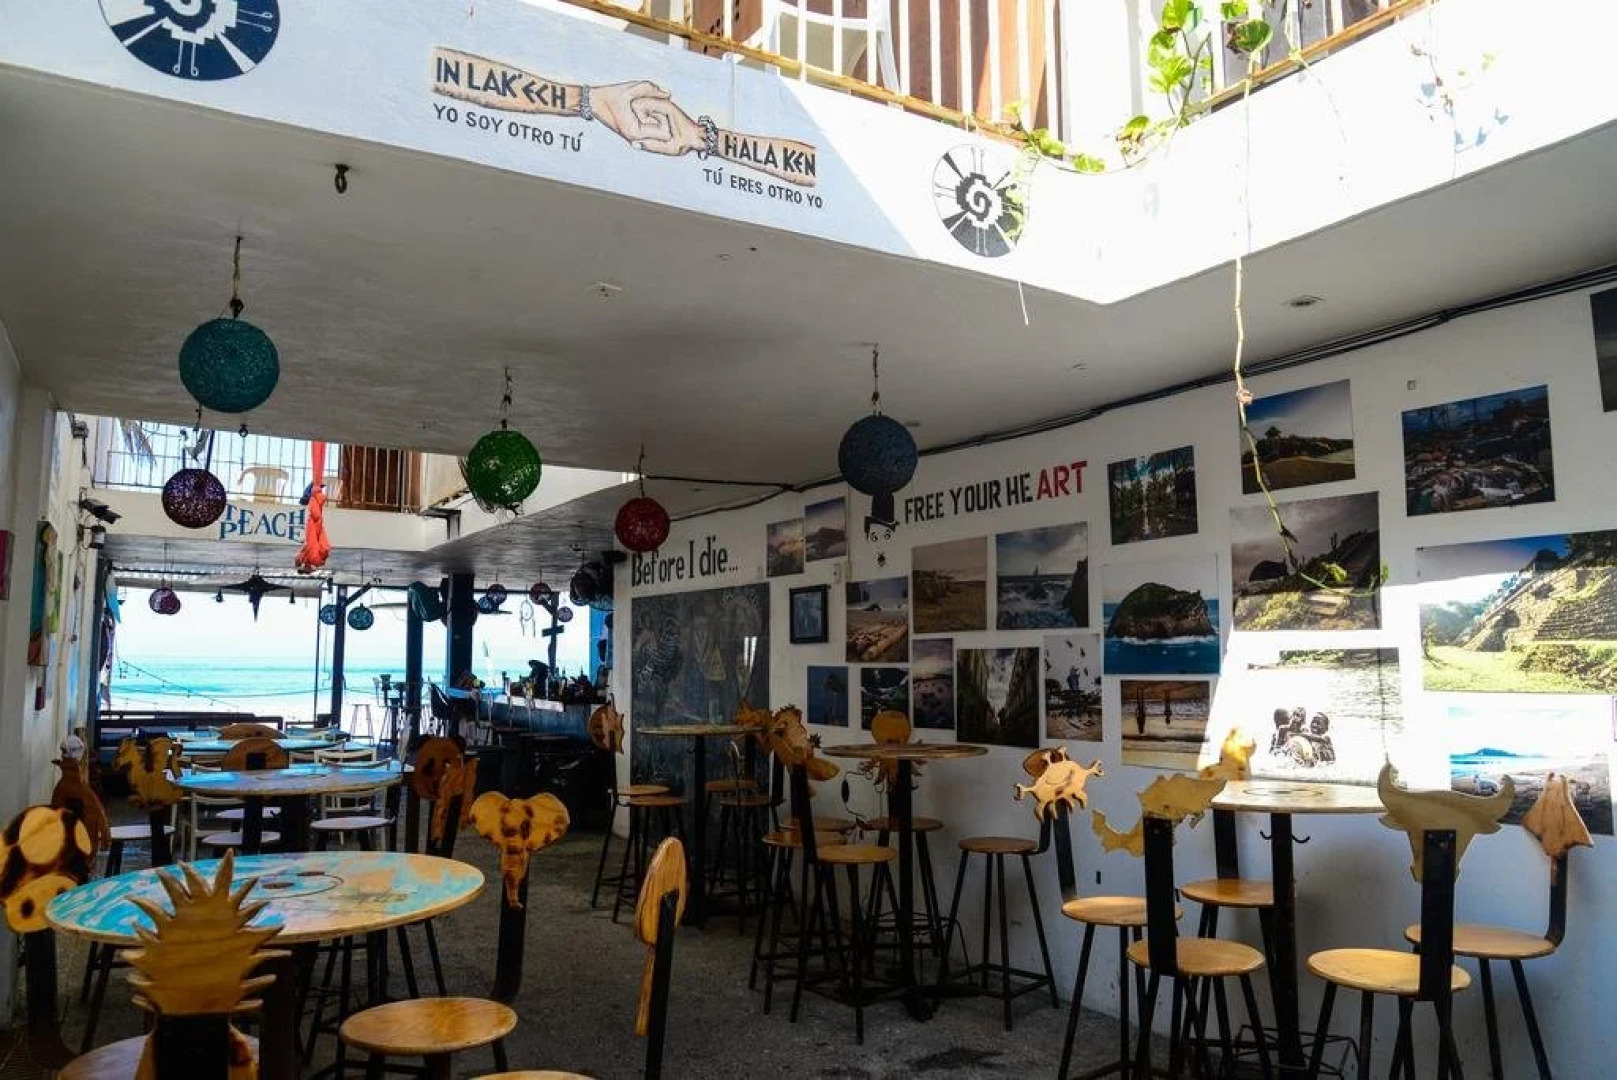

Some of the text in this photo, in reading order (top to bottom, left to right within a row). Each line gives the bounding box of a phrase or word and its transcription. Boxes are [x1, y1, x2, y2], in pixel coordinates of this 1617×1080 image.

[436, 57, 460, 86] IN
[433, 102, 584, 152] YO SOY OTRO TÚ
[724, 133, 816, 177] HALA KEN
[702, 166, 823, 209] TÚ ERES OTRO YO
[904, 491, 945, 525] FREE
[949, 479, 1002, 516] YOUR
[631, 549, 685, 587] Before
[688, 540, 696, 579] I
